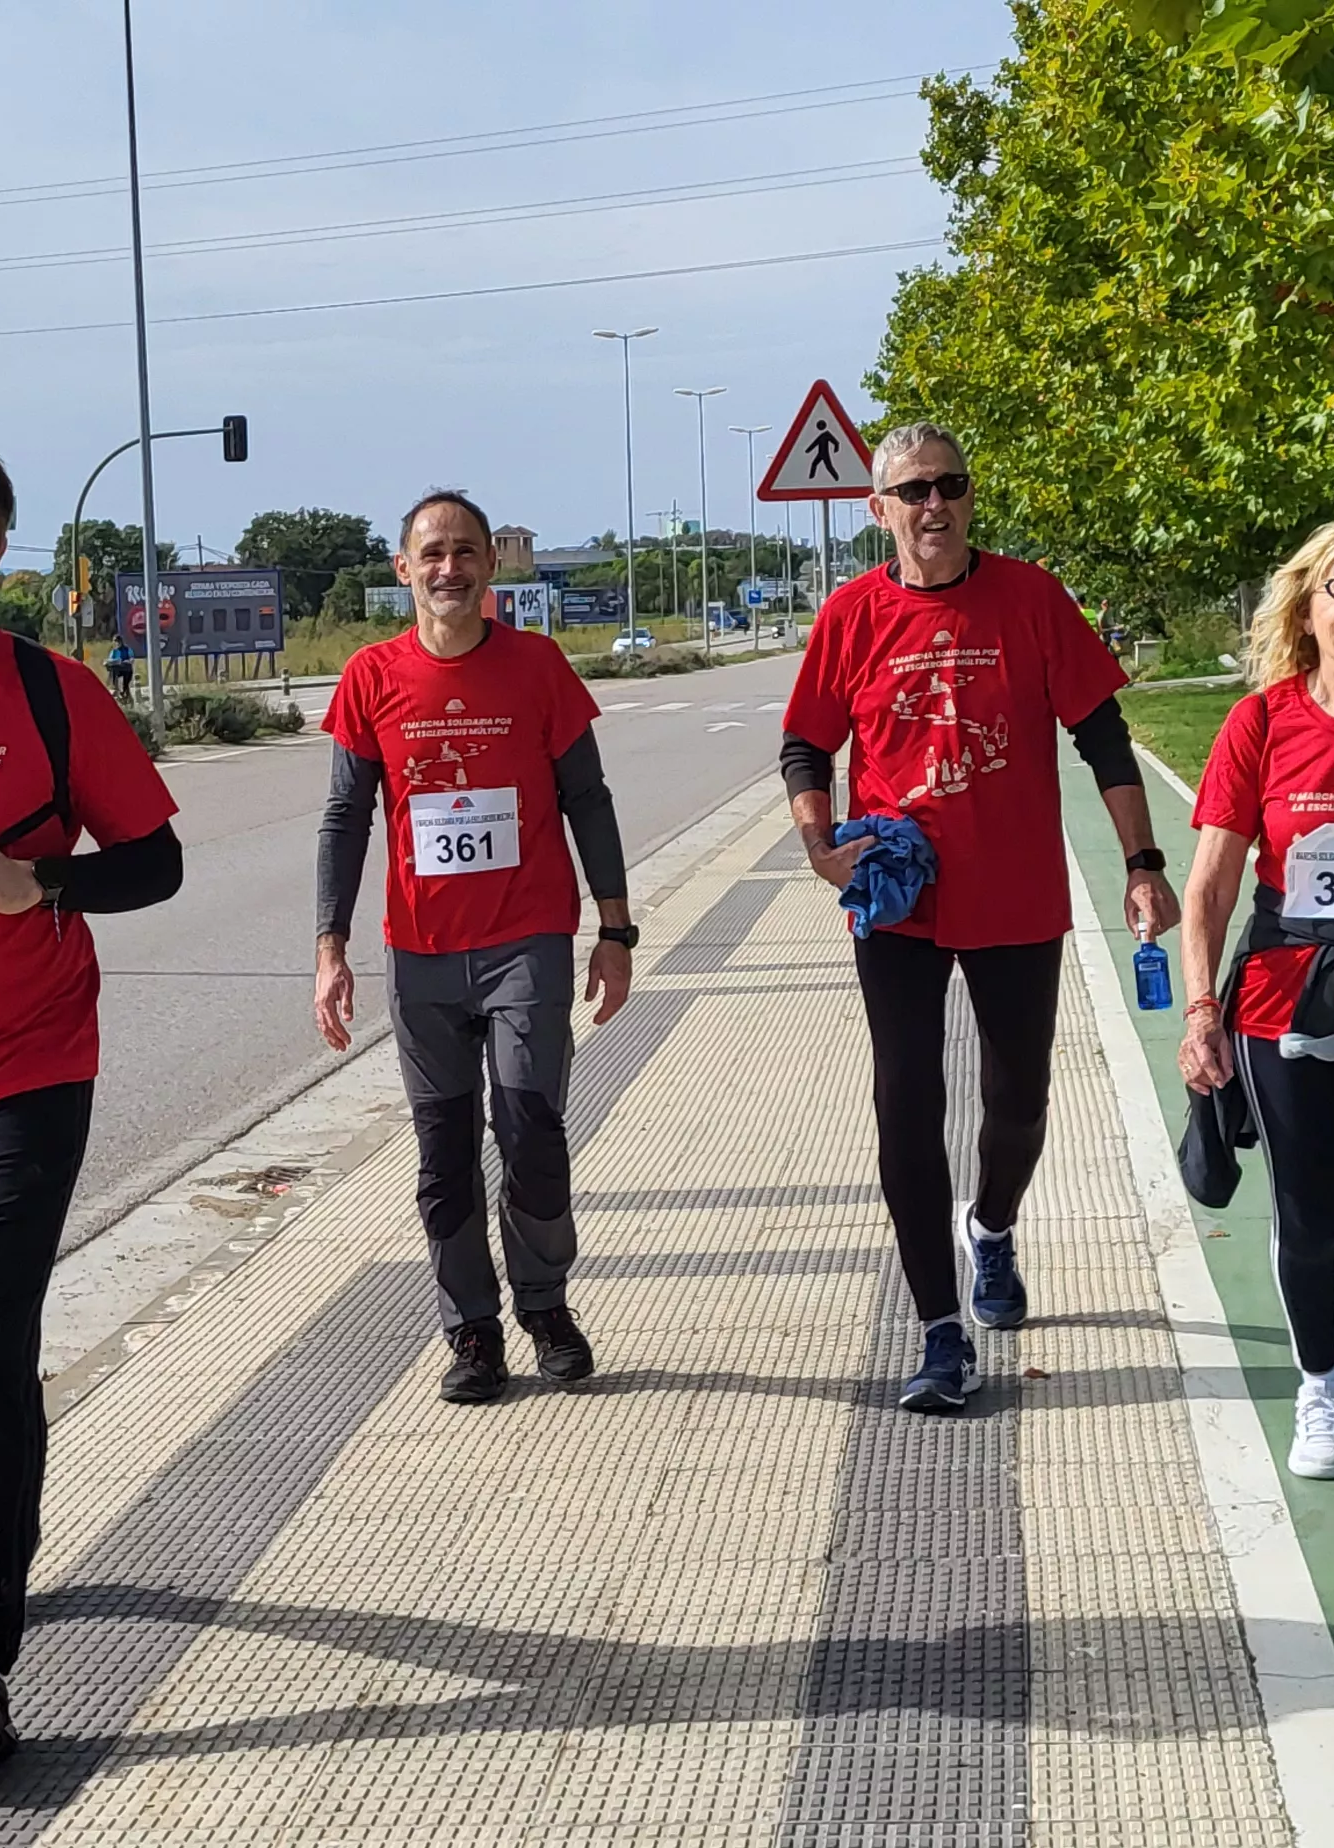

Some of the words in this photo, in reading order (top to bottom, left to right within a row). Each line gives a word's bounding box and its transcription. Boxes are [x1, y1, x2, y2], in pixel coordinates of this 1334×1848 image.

[519, 588, 541, 612] 495
[895, 651, 934, 665] MARCHA
[935, 649, 981, 658] SOLIDARIA
[893, 666, 904, 675] LA
[407, 719, 446, 730] MARCHA
[447, 717, 493, 726] SOLIDARIA
[494, 717, 513, 725] POR
[405, 731, 415, 740] LA
[416, 728, 467, 738] ESCLEROSIS
[1291, 803, 1305, 812] LA
[435, 830, 494, 864] 361
